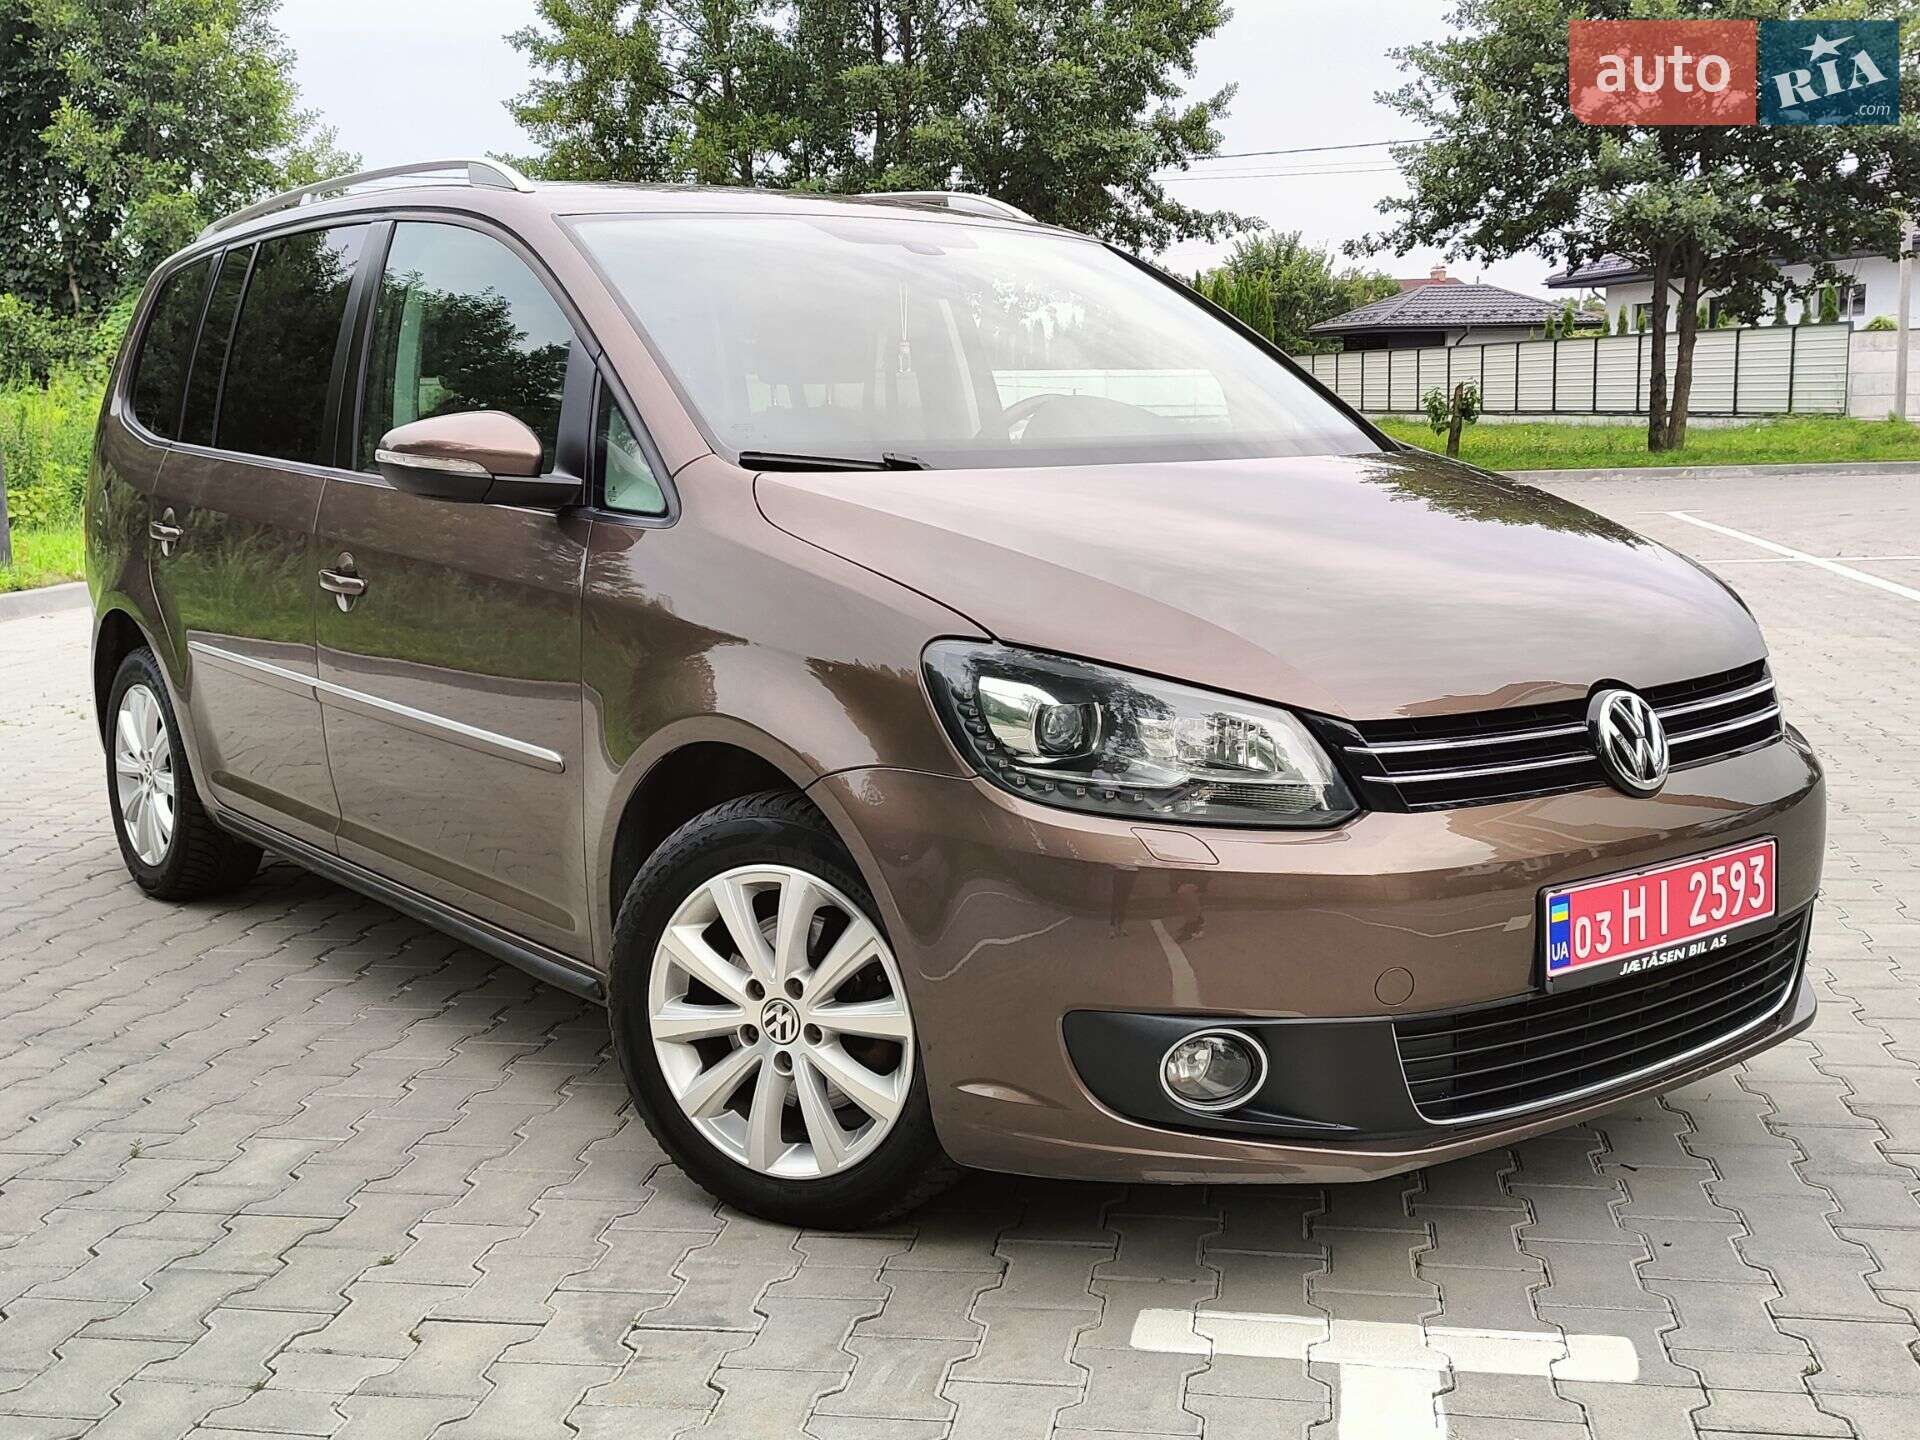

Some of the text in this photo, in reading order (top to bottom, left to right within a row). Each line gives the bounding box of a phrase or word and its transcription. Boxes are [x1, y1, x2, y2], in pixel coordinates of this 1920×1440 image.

[1574, 910, 1612, 959] 03
[1688, 854, 1766, 927] 2593
[1551, 941, 1570, 961] UA
[1619, 934, 1728, 976] JÆTÅSEN BIL AS
